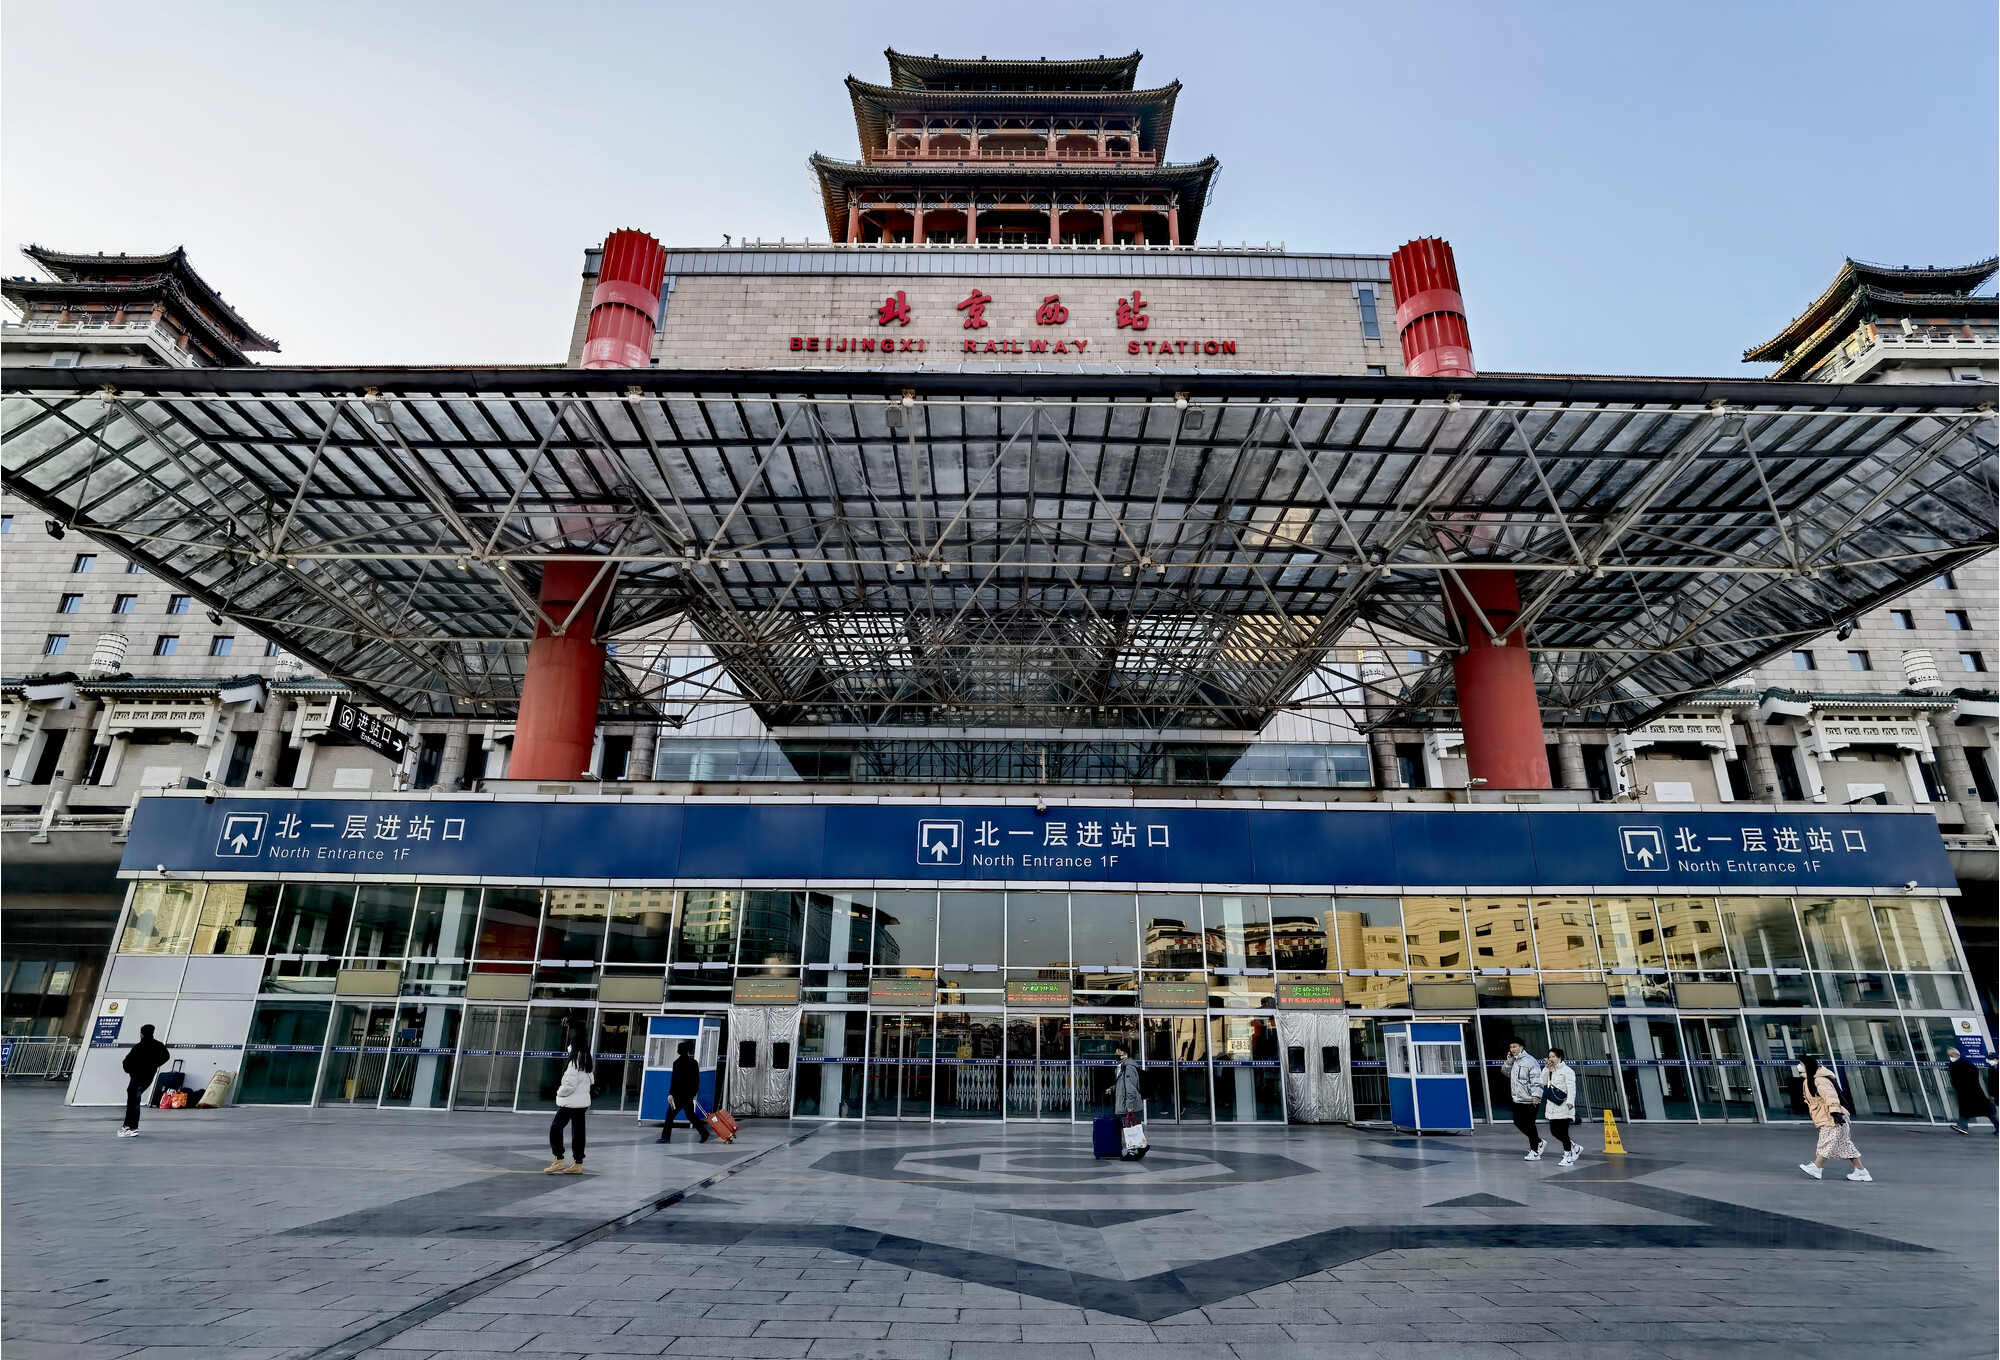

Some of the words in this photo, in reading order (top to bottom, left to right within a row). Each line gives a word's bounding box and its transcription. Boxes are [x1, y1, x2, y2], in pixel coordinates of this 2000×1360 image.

[877, 288, 1150, 330] 北京西站
[789, 336, 925, 353] BEIJINGXI
[963, 338, 1089, 355] RAILWAY
[1127, 339, 1238, 355] STATION
[357, 712, 391, 743] 进站口
[361, 732, 383, 749] Entrance
[275, 813, 466, 841] 北一层进站口
[973, 820, 1170, 848] 北一层进站口
[1674, 826, 1867, 853] 北一层进站口
[269, 845, 310, 859] North
[317, 846, 384, 860] Entrance
[393, 848, 411, 861] 1F
[972, 853, 1015, 867] North
[1022, 854, 1092, 867] Entrance
[1100, 855, 1119, 868] 1F
[1678, 859, 1720, 872] North
[1726, 860, 1796, 873] Entrance
[1803, 860, 1821, 873] 1F
